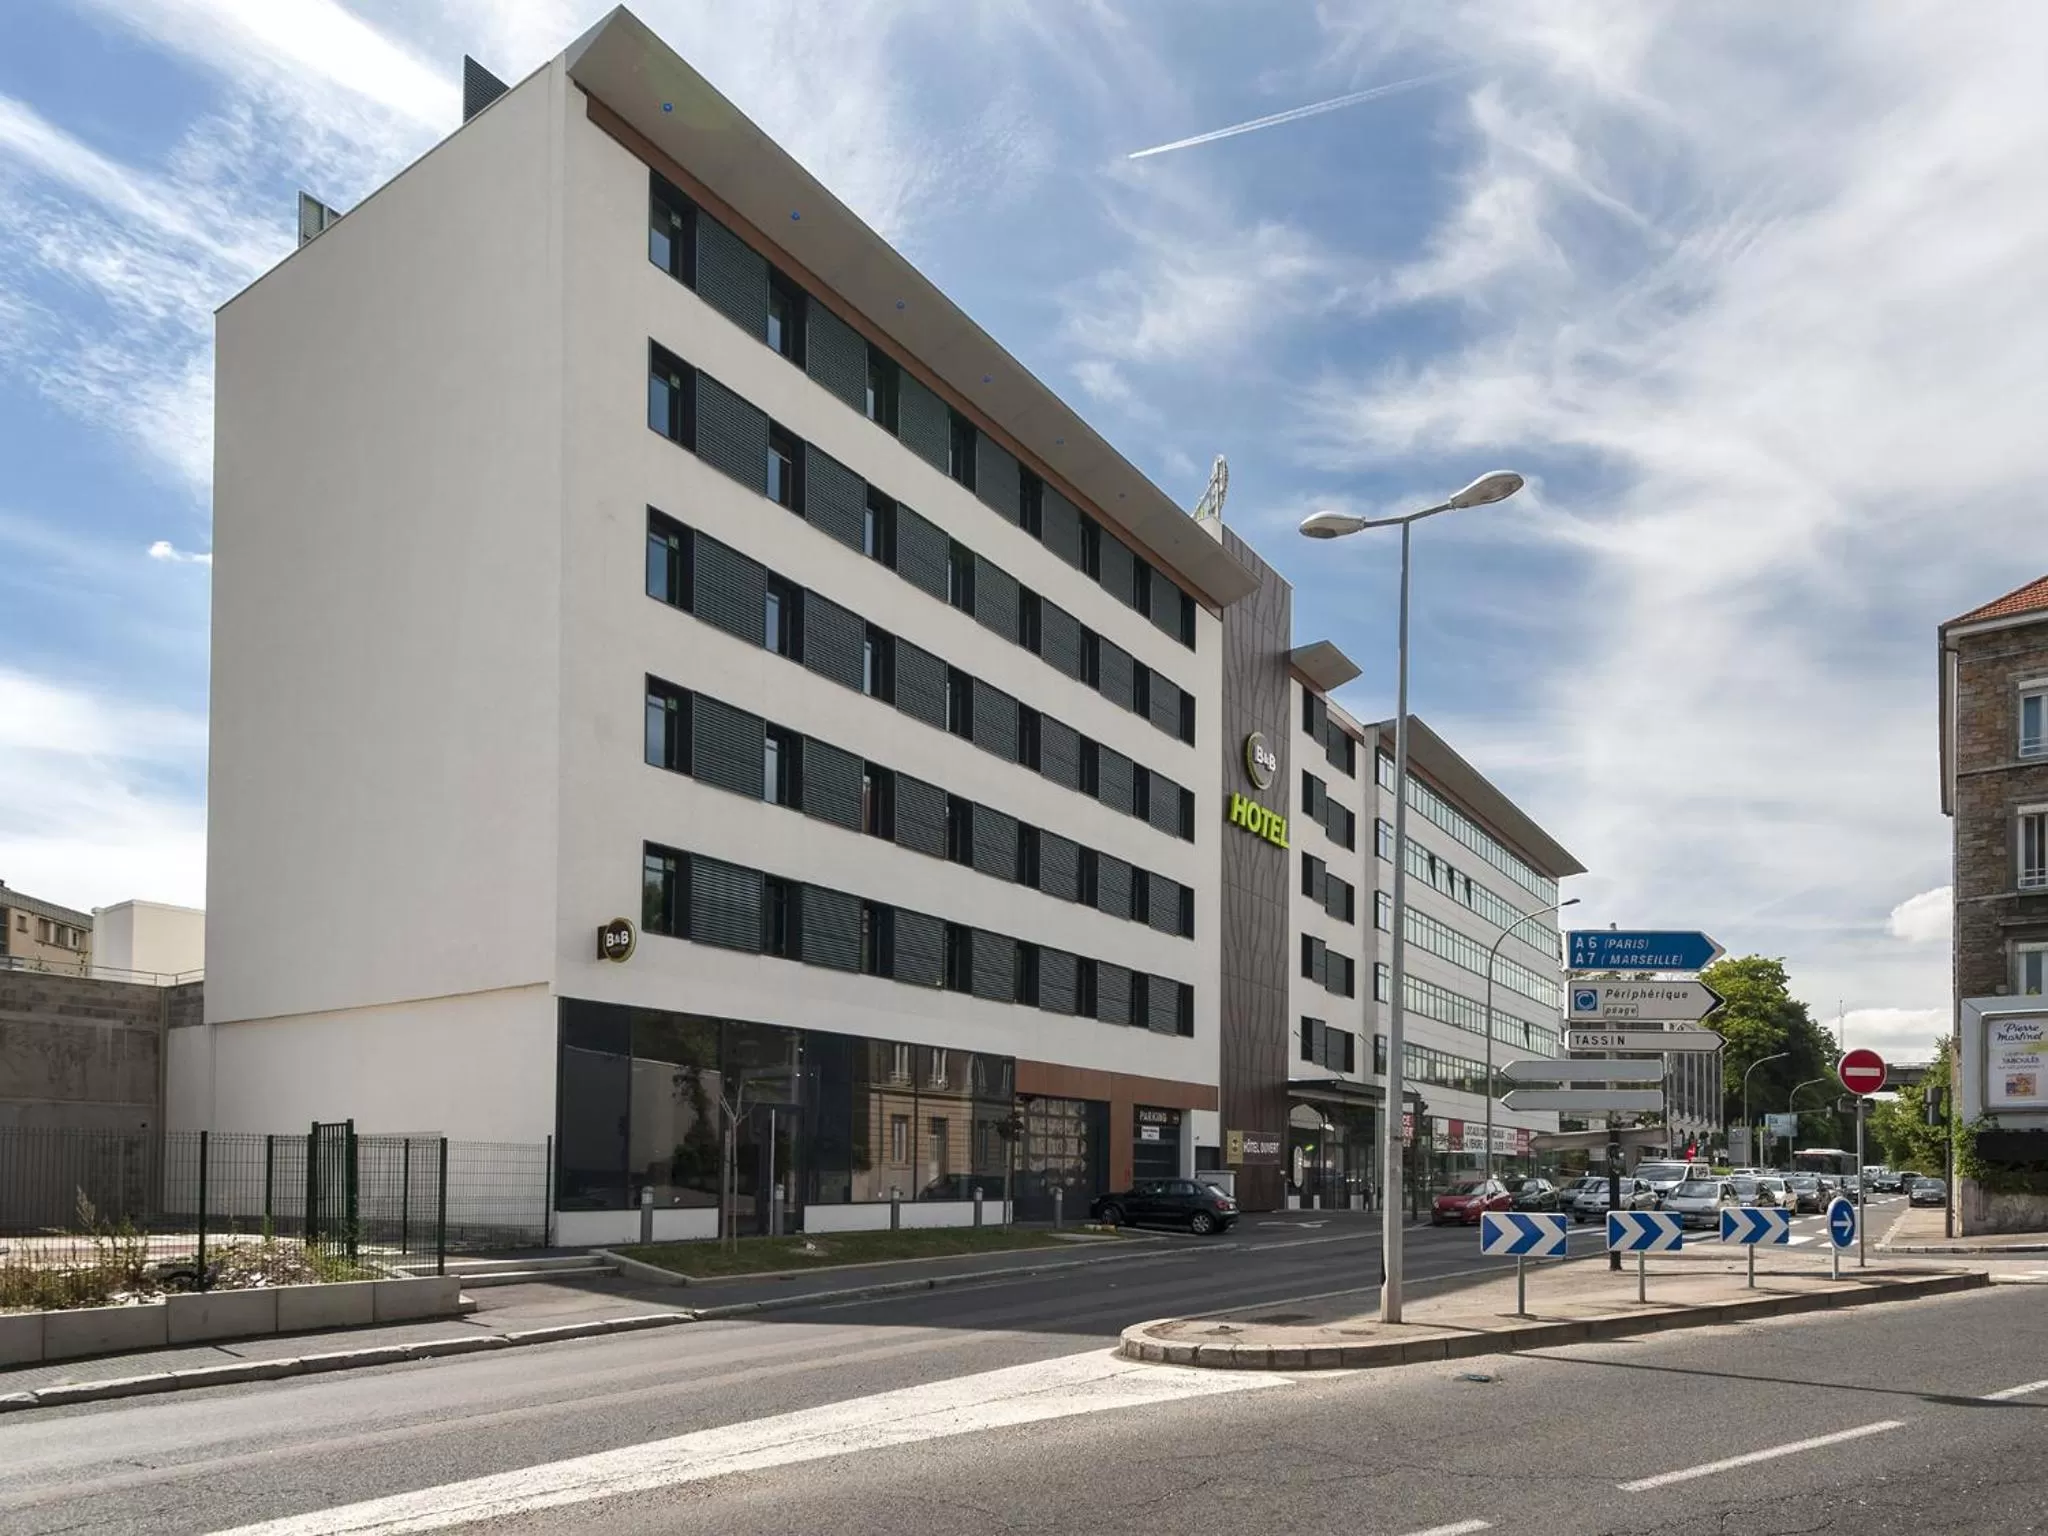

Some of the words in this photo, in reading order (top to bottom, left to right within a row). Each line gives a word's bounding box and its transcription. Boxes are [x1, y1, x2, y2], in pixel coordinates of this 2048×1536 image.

[1230, 792, 1291, 849] HOTEL
[1604, 938, 1649, 950] (PARIS)
[1605, 988, 1689, 1001] Périphérique
[1605, 1005, 1637, 1017] péage
[2003, 1022, 2040, 1033] Pierre
[1575, 1034, 1626, 1046] TASSIN
[1139, 1110, 1168, 1123] PARKING
